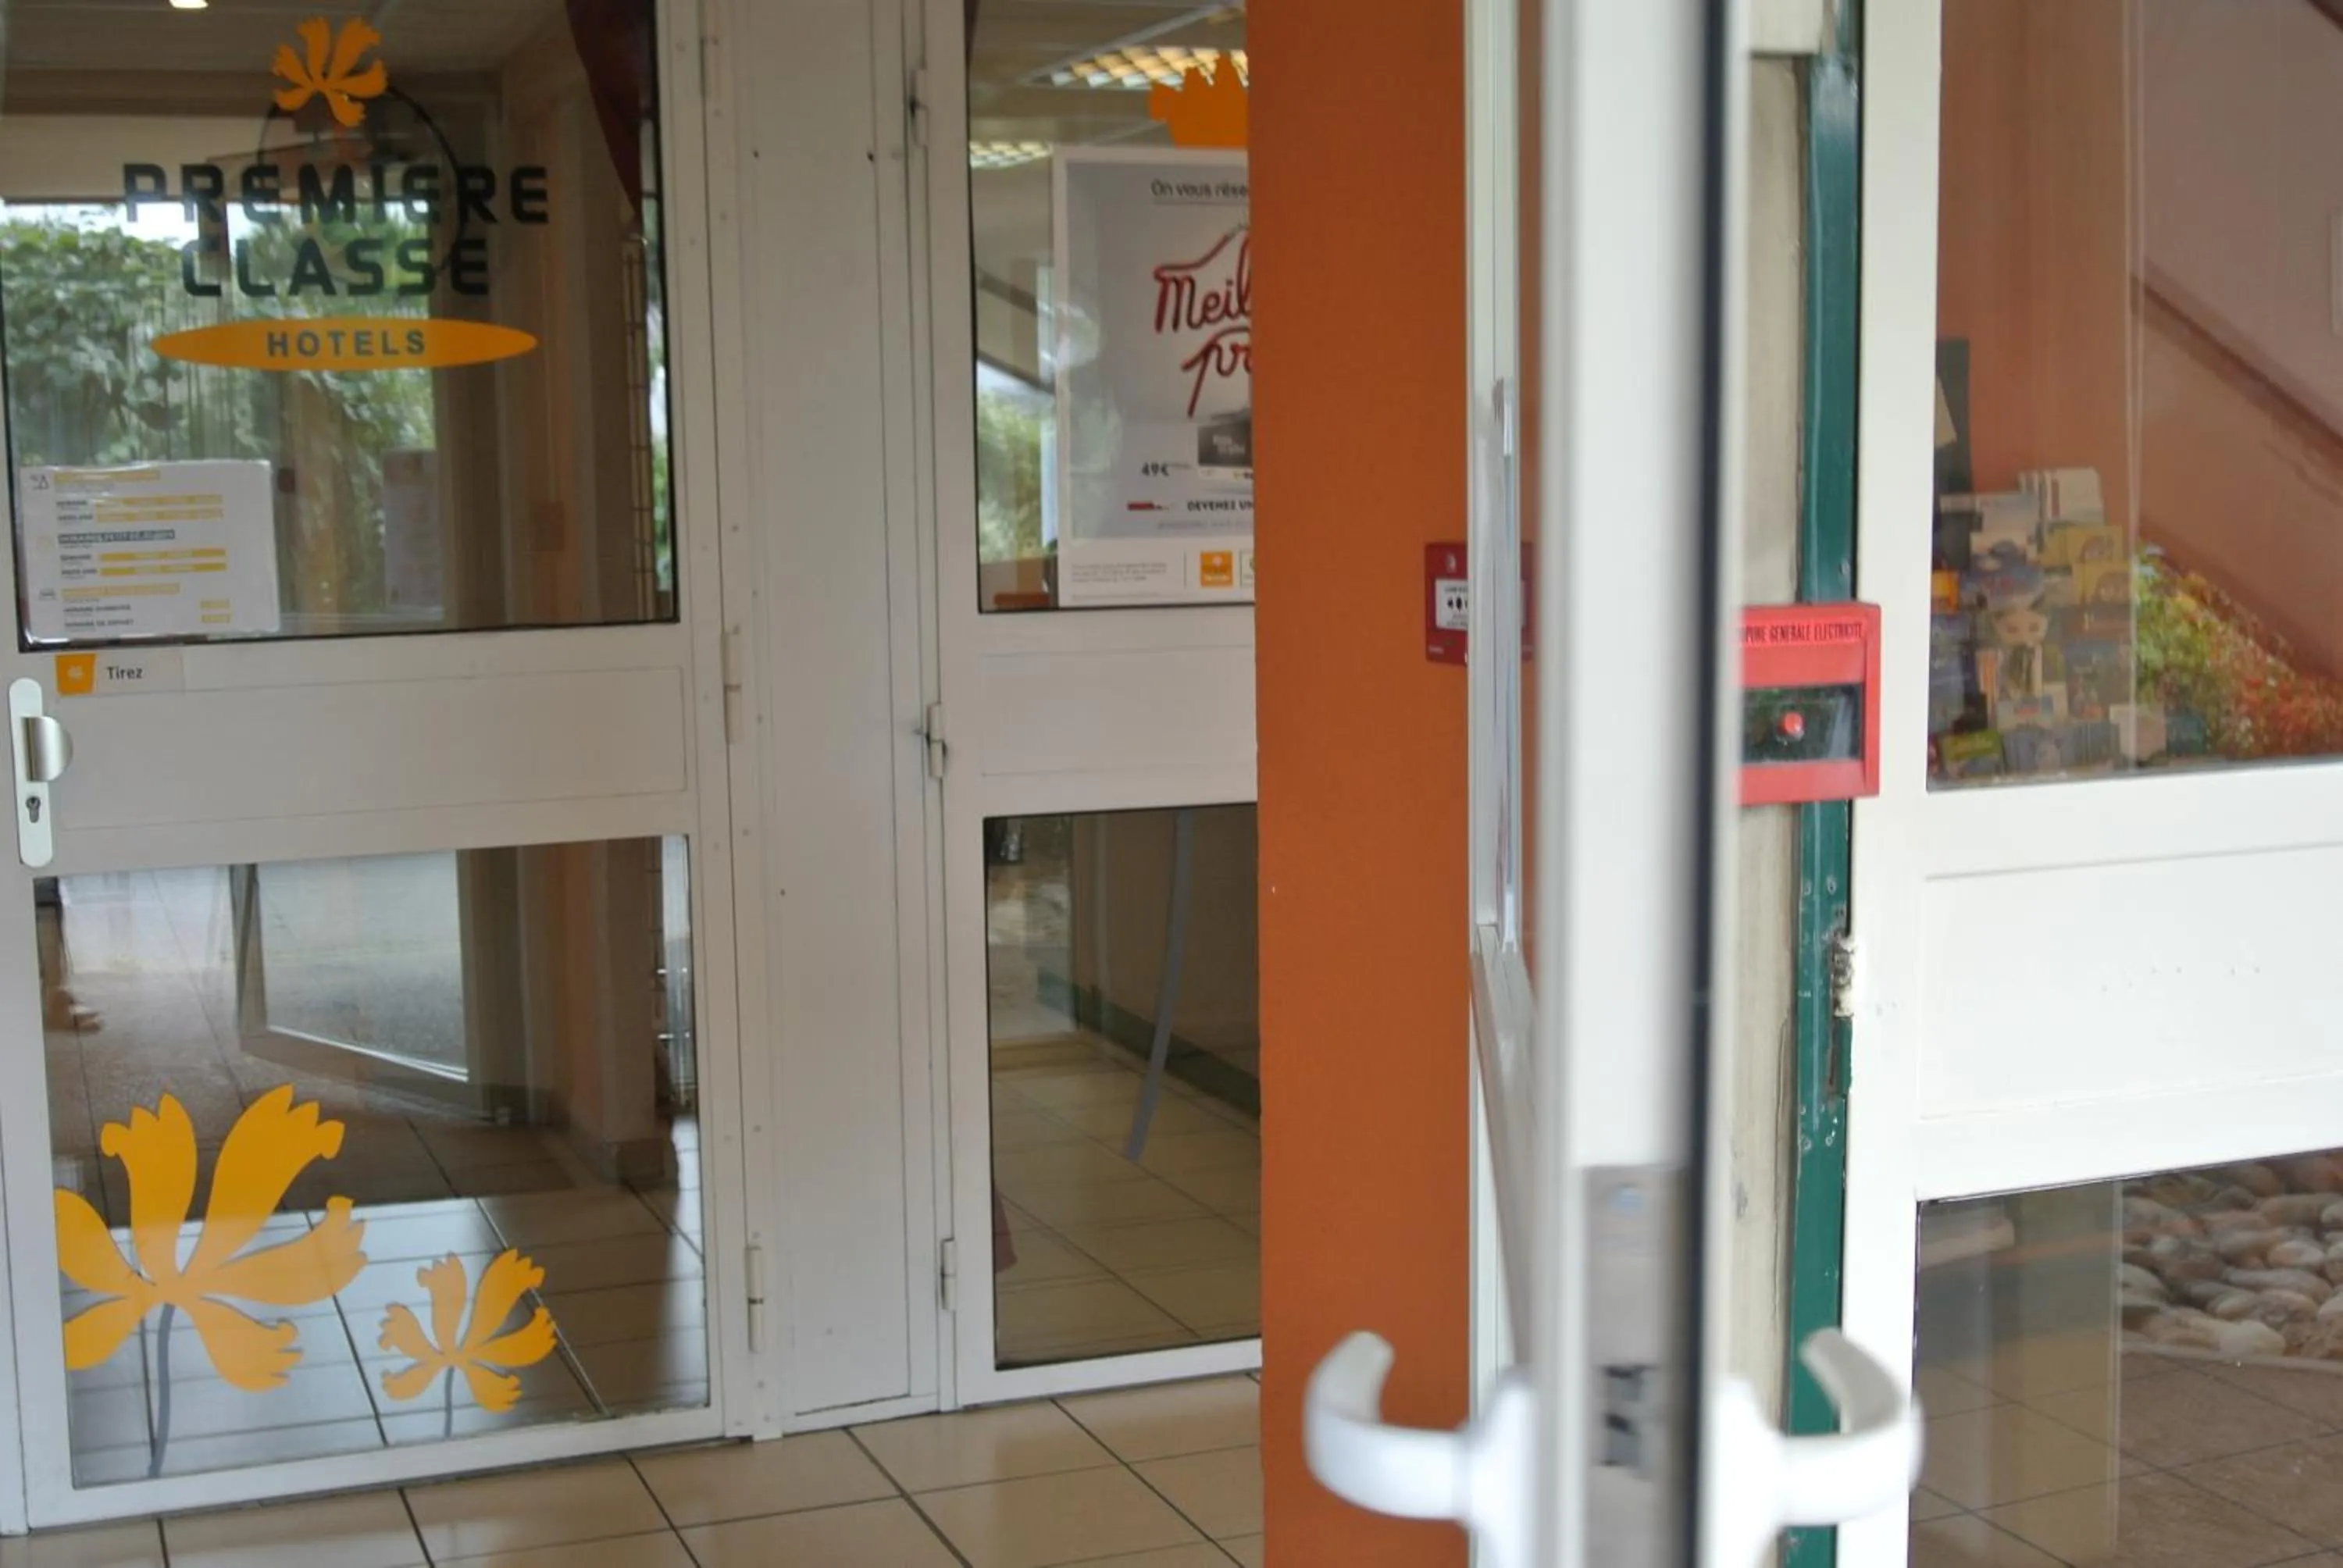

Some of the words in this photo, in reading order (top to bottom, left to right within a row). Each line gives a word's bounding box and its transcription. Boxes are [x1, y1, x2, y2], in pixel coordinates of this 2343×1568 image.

[123, 162, 549, 225] PREMIERE
[1151, 178, 1173, 197] On
[1176, 182, 1211, 199] vous
[181, 238, 490, 298] CLASSE
[266, 330, 426, 358] HOTELS
[1769, 623, 1810, 642] GENERALE
[106, 665, 143, 679] Tirez
